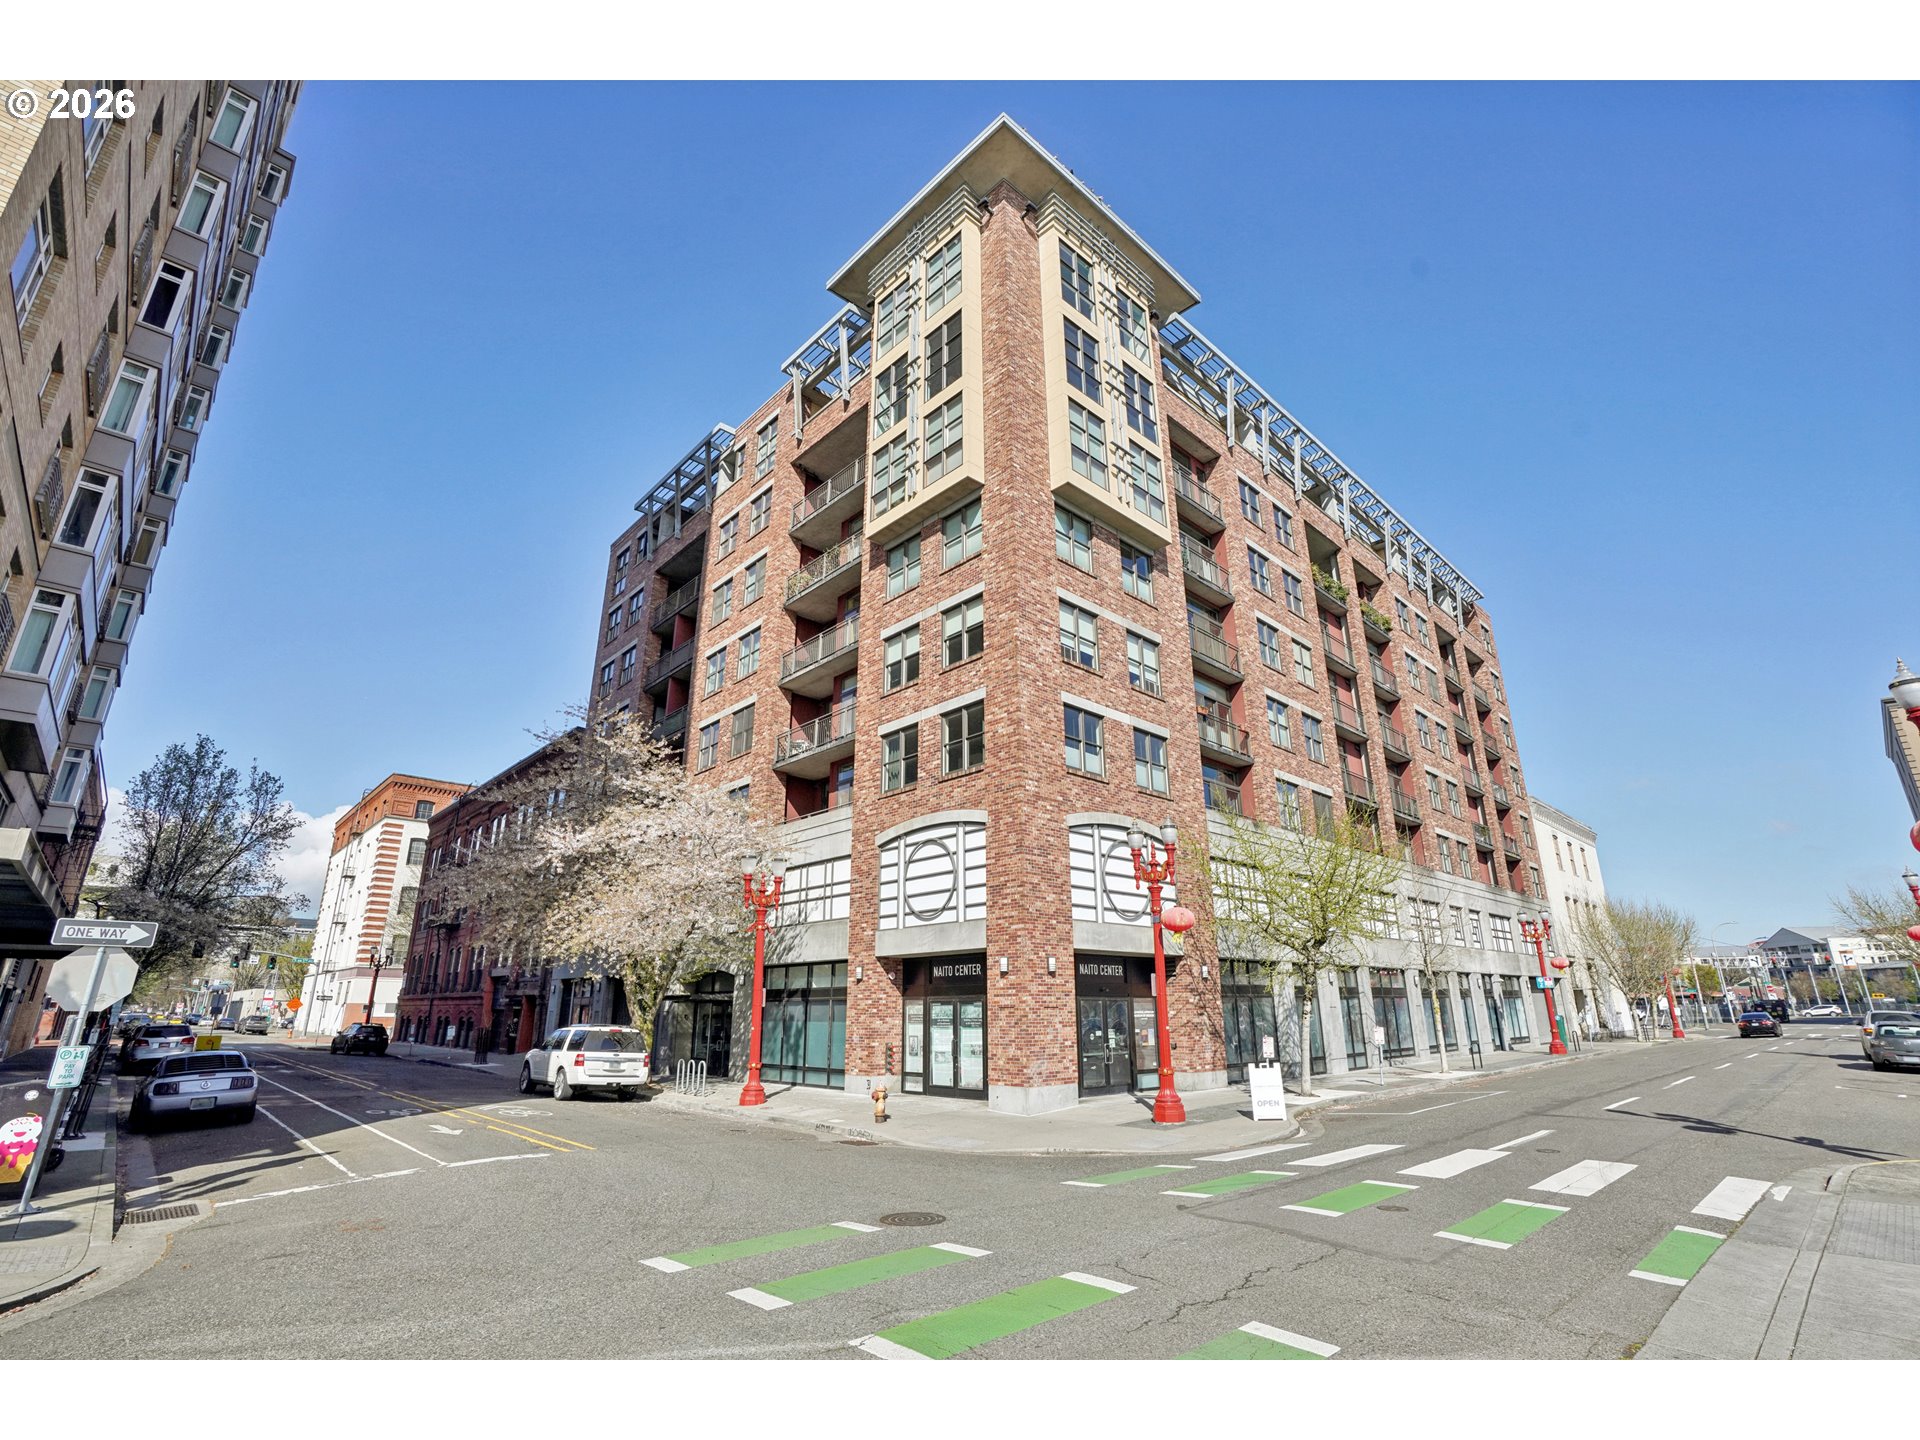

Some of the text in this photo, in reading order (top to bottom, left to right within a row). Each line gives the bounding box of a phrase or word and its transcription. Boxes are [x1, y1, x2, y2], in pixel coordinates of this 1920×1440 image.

[66, 926, 127, 938] ONE WAY
[933, 963, 982, 978] NAITO CENTER
[1079, 963, 1124, 976] NAITO CENTER
[1257, 1099, 1280, 1107] OPEN
